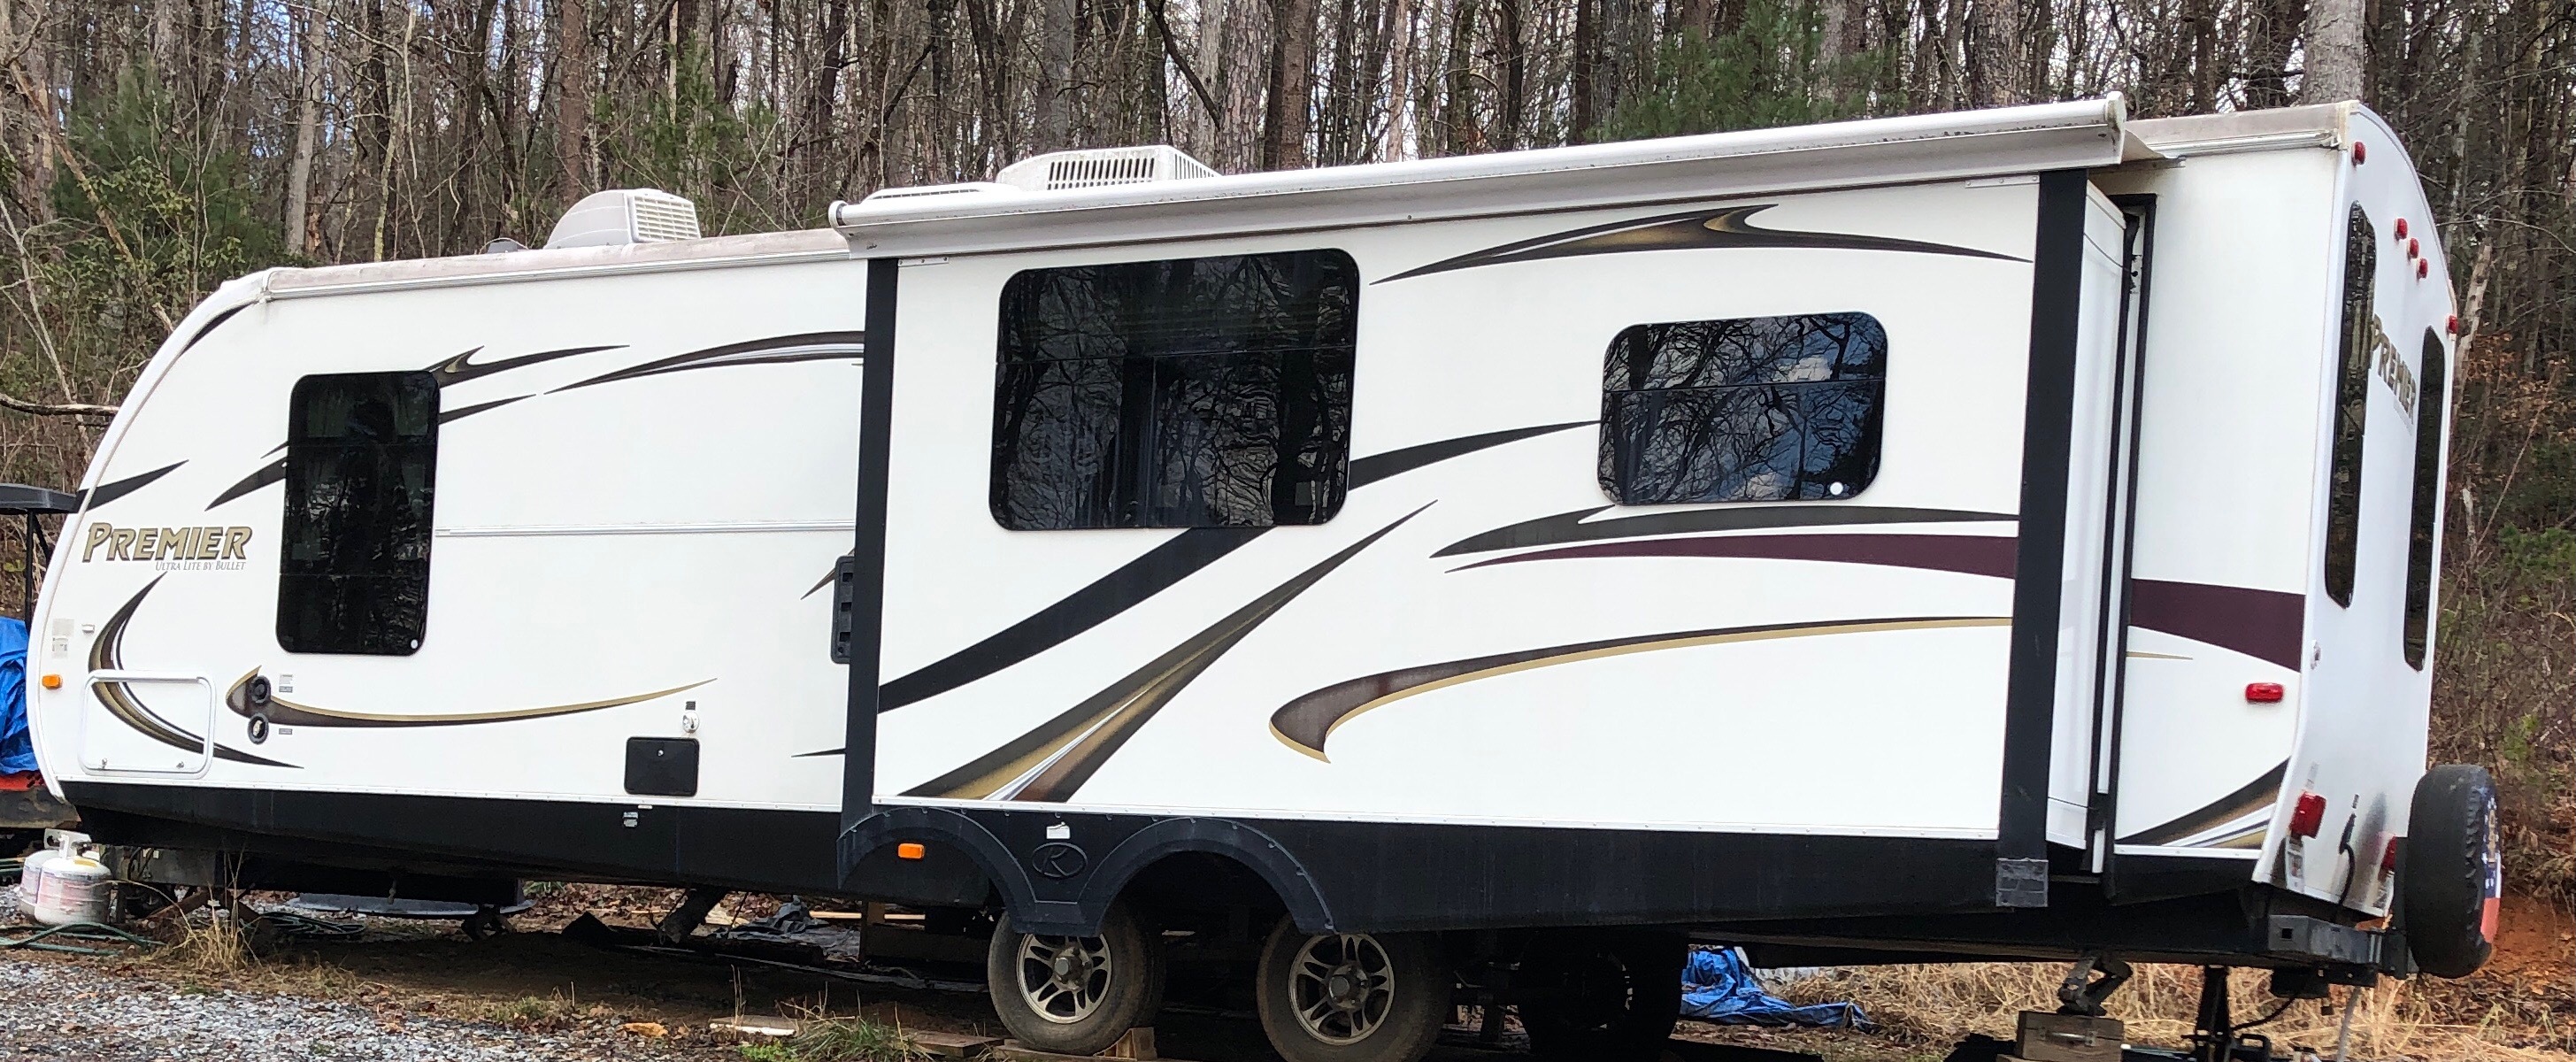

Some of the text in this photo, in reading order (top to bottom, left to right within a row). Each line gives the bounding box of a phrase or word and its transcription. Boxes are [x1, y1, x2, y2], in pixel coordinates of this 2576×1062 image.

[2368, 313, 2417, 425] PREMIER
[82, 522, 253, 563] PREMIER
[155, 560, 247, 572] ULTRA LITE BY BULLET
